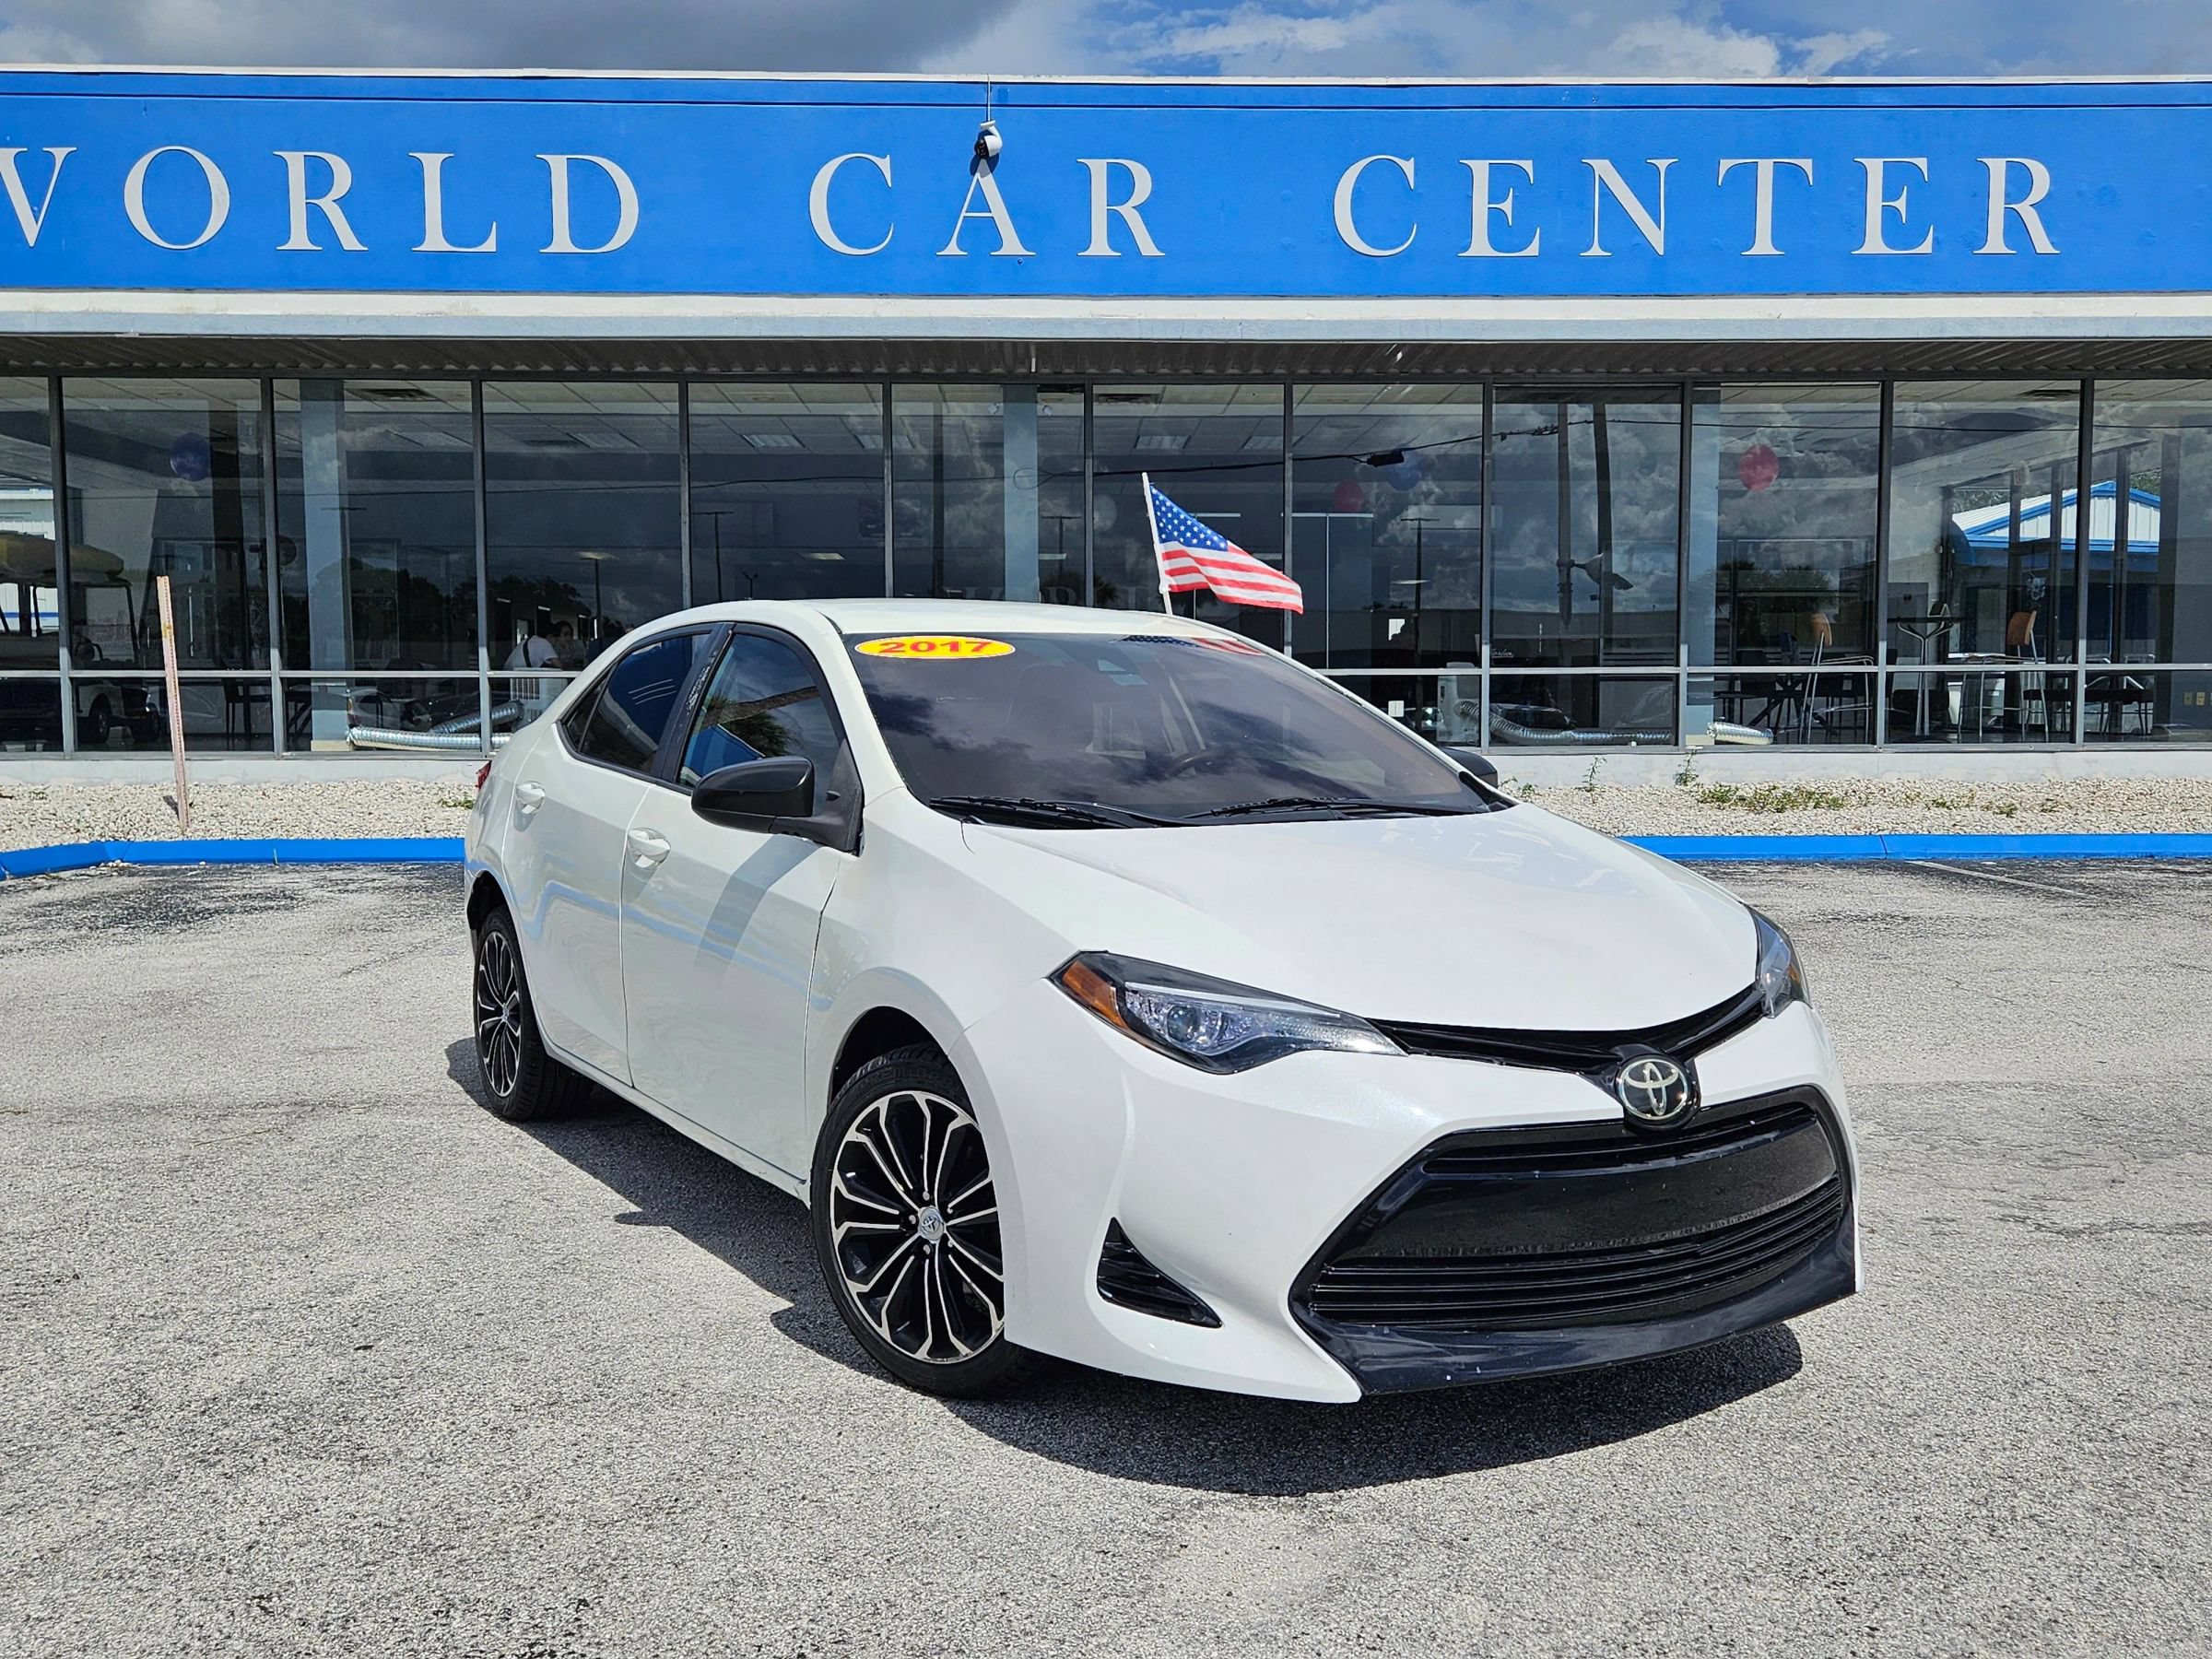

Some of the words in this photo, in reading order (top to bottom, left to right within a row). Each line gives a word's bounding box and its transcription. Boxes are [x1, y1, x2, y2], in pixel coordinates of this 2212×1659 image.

[808, 152, 1166, 256] CAR
[1333, 154, 2062, 257] CENTER
[878, 641, 994, 653] 2017
